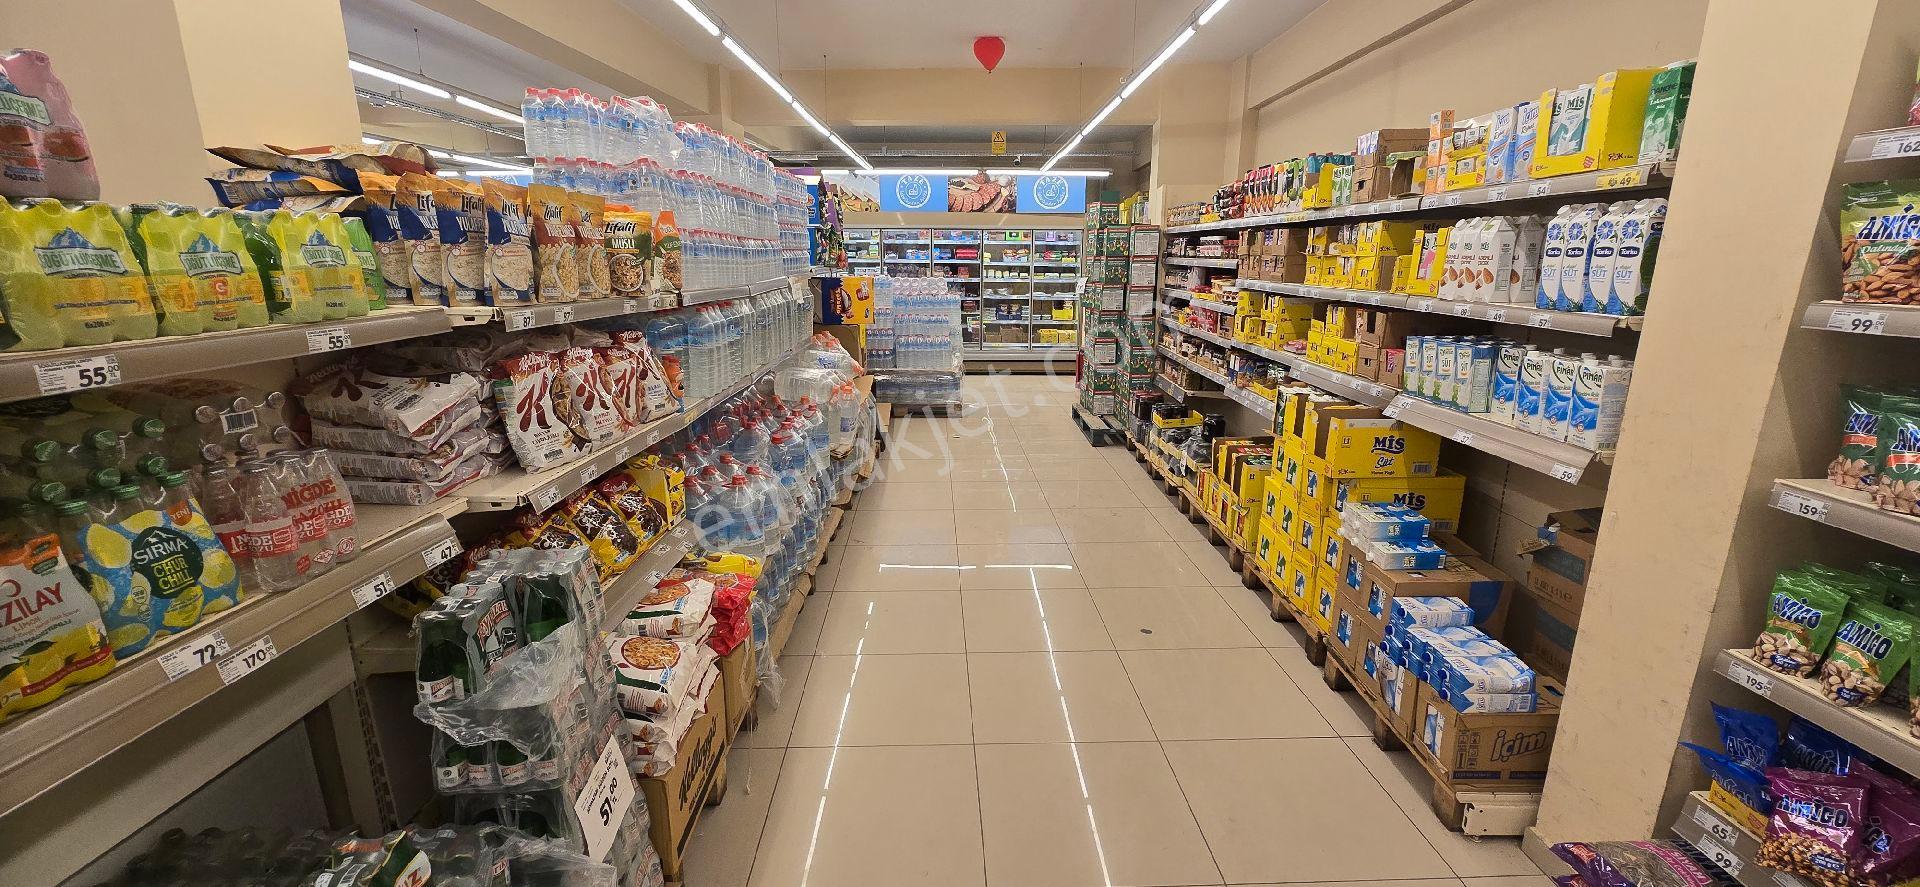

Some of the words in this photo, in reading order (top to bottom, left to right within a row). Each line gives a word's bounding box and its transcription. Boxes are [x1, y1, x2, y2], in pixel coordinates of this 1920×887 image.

[1568, 96, 1584, 108] MİS
[605, 222, 638, 234] Lifalif
[1857, 203, 1920, 240] AMİG
[1373, 435, 1405, 452] MİS
[1393, 492, 1426, 511] MİS
[133, 538, 189, 565] SIRMA
[153, 557, 189, 577] CHUR
[158, 569, 193, 590] CHILL
[0, 582, 63, 629] ZILAY
[1773, 592, 1823, 630] AMİGO
[1836, 620, 1894, 661] AMİGO
[1777, 794, 1849, 828] AMİGO
